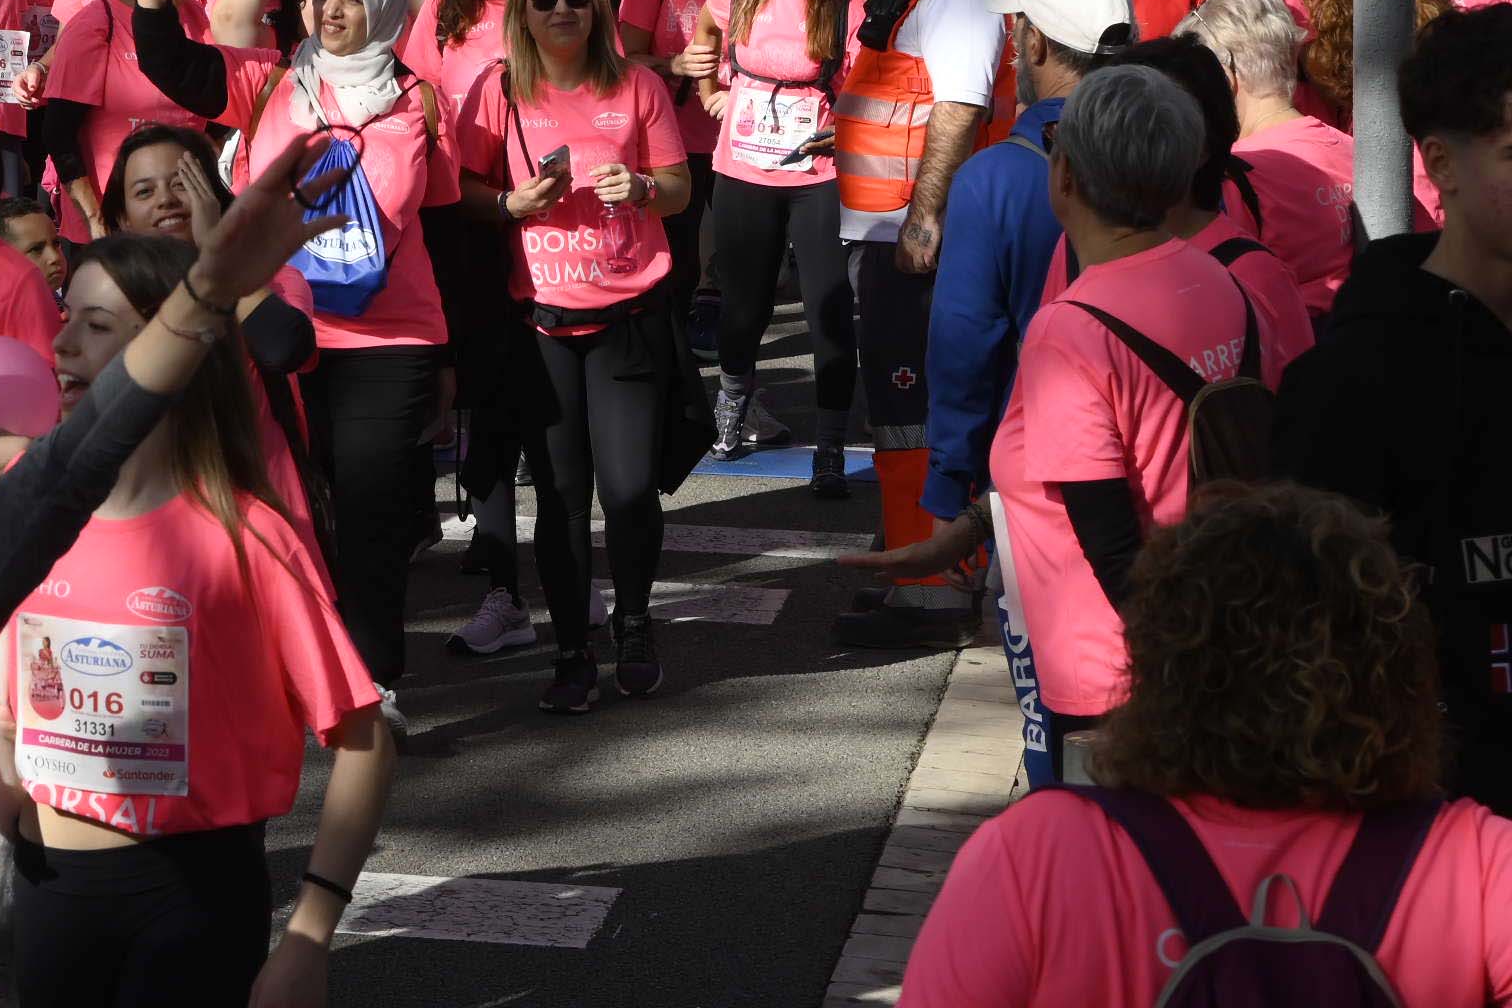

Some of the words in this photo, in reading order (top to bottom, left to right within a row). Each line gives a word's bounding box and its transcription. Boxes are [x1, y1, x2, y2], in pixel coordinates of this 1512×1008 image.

[532, 262, 605, 285] SUMA
[132, 597, 187, 614] ASTURIANA
[65, 651, 127, 670] ASTURIANA
[139, 650, 176, 659] SUMA
[69, 687, 124, 714] 016
[74, 719, 116, 737] 31331
[38, 733, 76, 749] CARRERA
[77, 741, 89, 751] DE
[90, 743, 103, 753] LA
[105, 745, 142, 756] MUJER
[34, 756, 76, 773] OYSHO
[117, 768, 176, 782] Santander
